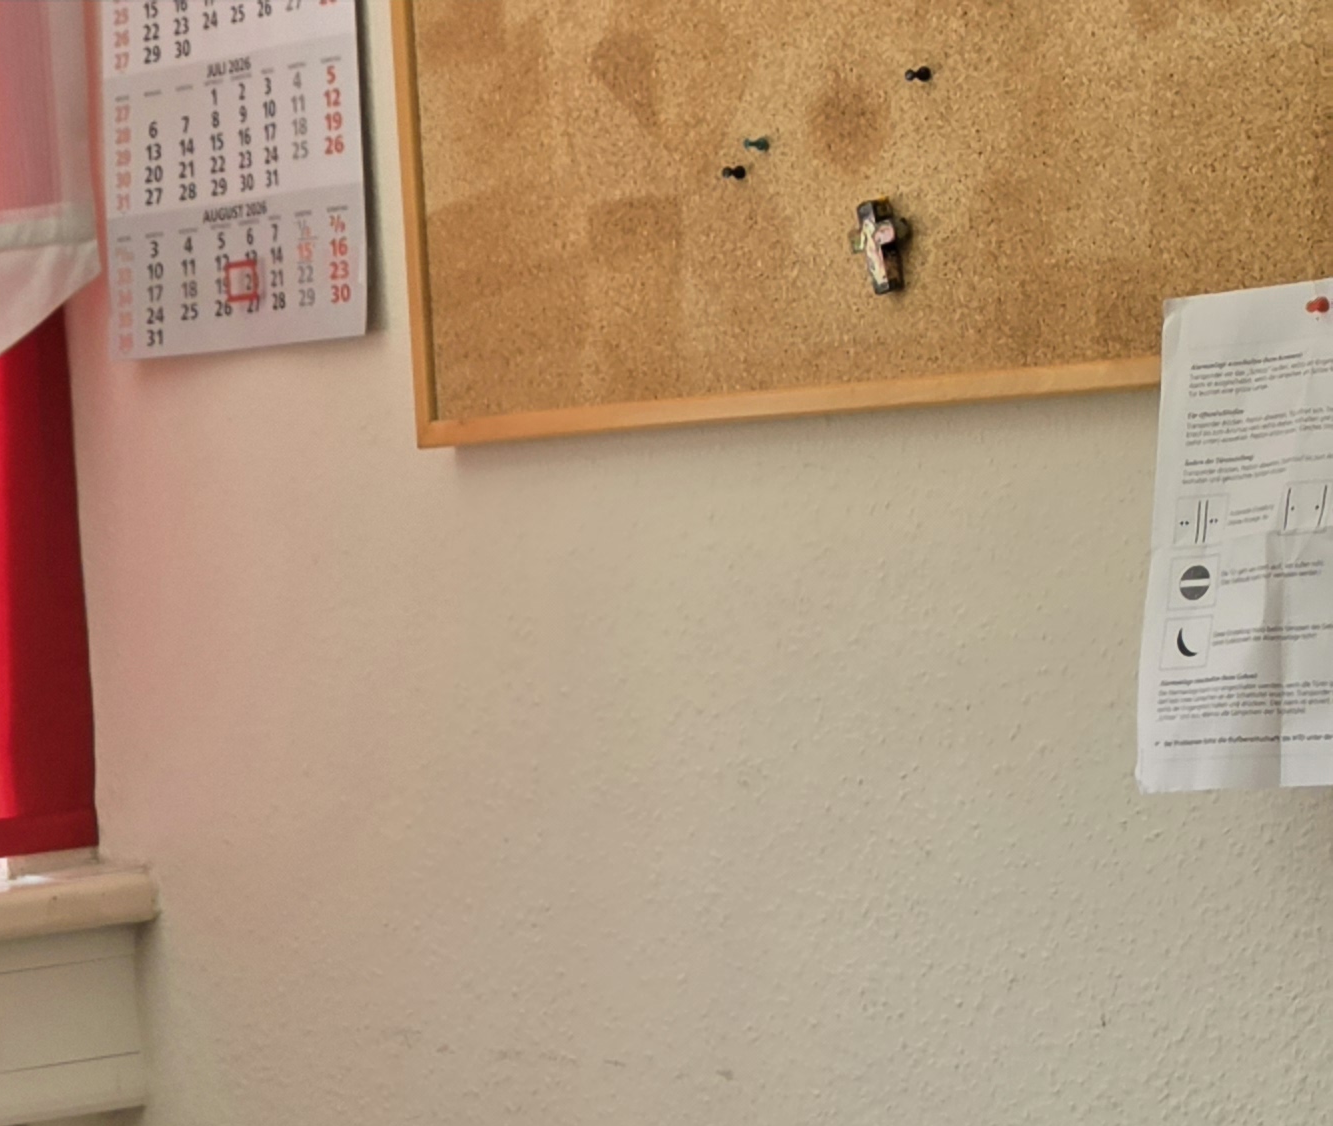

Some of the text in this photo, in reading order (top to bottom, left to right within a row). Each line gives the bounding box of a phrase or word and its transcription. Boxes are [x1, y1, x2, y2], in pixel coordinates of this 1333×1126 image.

[143, 0, 159, 19] 15
[143, 22, 160, 42] 22
[174, 16, 190, 36] 23
[202, 10, 218, 30] 24
[230, 4, 245, 24] 25
[257, 0, 272, 18] 26
[143, 45, 161, 64] 29
[174, 39, 191, 58] 30
[206, 56, 252, 78] JULI 2026
[211, 88, 218, 106] 1
[238, 82, 246, 101] 2
[264, 77, 272, 95] 3
[293, 71, 302, 89] 4
[326, 65, 336, 85] 5
[148, 120, 158, 139] 6
[181, 115, 190, 134] 7
[211, 110, 220, 129] 8
[239, 105, 248, 124] 9
[263, 99, 276, 119] 10
[291, 94, 306, 113] 11
[323, 88, 341, 108] 12
[145, 142, 162, 161] 13
[179, 137, 195, 157] 14
[209, 132, 224, 151] 15
[238, 127, 252, 146] 16
[263, 122, 276, 142] 17
[291, 117, 308, 136] 18
[324, 111, 343, 131] 19
[144, 165, 163, 184] 20
[178, 161, 195, 179] 21
[210, 155, 226, 174] 22
[238, 150, 252, 169] 23
[264, 145, 278, 165] 24
[292, 140, 309, 160] 25
[324, 134, 345, 155] 26
[145, 187, 163, 206] 27
[178, 182, 197, 202] 28
[211, 177, 228, 197] 29
[240, 172, 254, 192] 30
[265, 168, 279, 188] 31
[203, 204, 244, 223] AUGUST
[246, 200, 268, 217] 2026
[146, 261, 164, 280] 10
[181, 258, 196, 277] 11
[270, 245, 283, 264] 14
[329, 236, 348, 258] 16
[149, 240, 159, 259] 3
[184, 236, 193, 254] 4
[217, 231, 226, 250] 5
[246, 226, 254, 245] 6
[270, 223, 278, 242] 7
[147, 284, 164, 302] 17
[180, 280, 197, 299] 18
[270, 269, 284, 288] 21
[297, 264, 314, 284] 22
[329, 259, 349, 281] 23
[146, 306, 165, 325] 24
[180, 302, 199, 321] 25
[214, 299, 233, 317] 26
[272, 291, 286, 311] 28
[298, 287, 315, 307] 29
[330, 283, 351, 304] 30
[146, 328, 165, 347] 31
